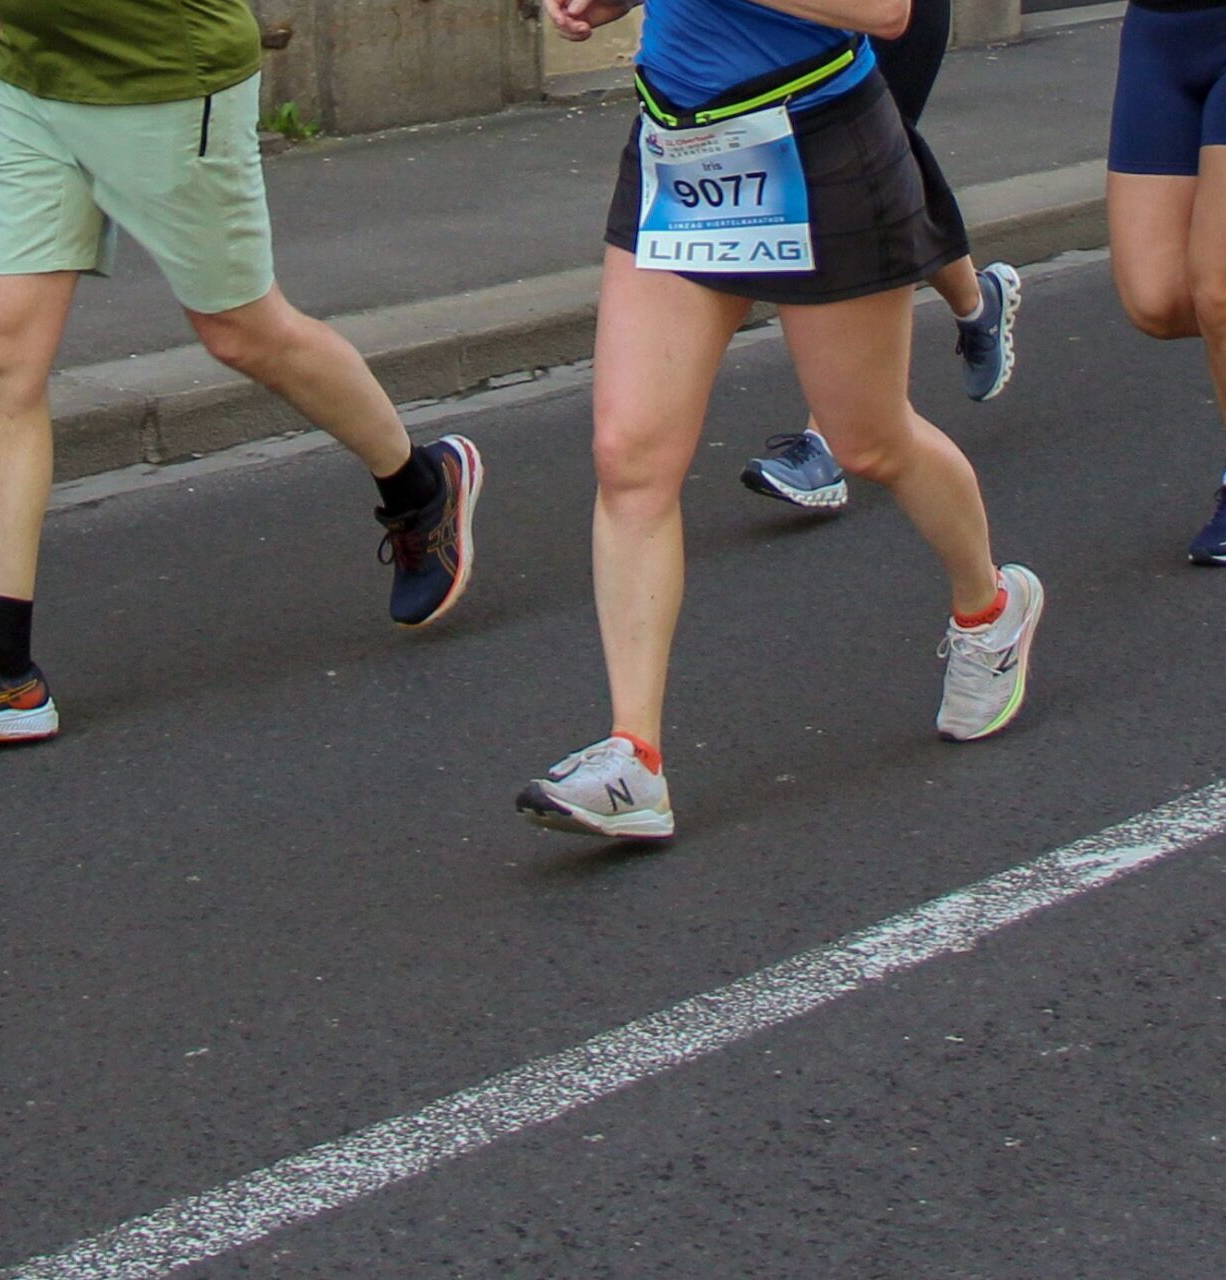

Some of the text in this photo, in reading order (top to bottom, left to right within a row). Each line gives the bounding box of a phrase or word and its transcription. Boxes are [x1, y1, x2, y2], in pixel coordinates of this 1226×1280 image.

[702, 161, 723, 171] Iris
[673, 171, 768, 209] 9077
[649, 240, 802, 261] LINZ AG
[605, 778, 634, 812] N
